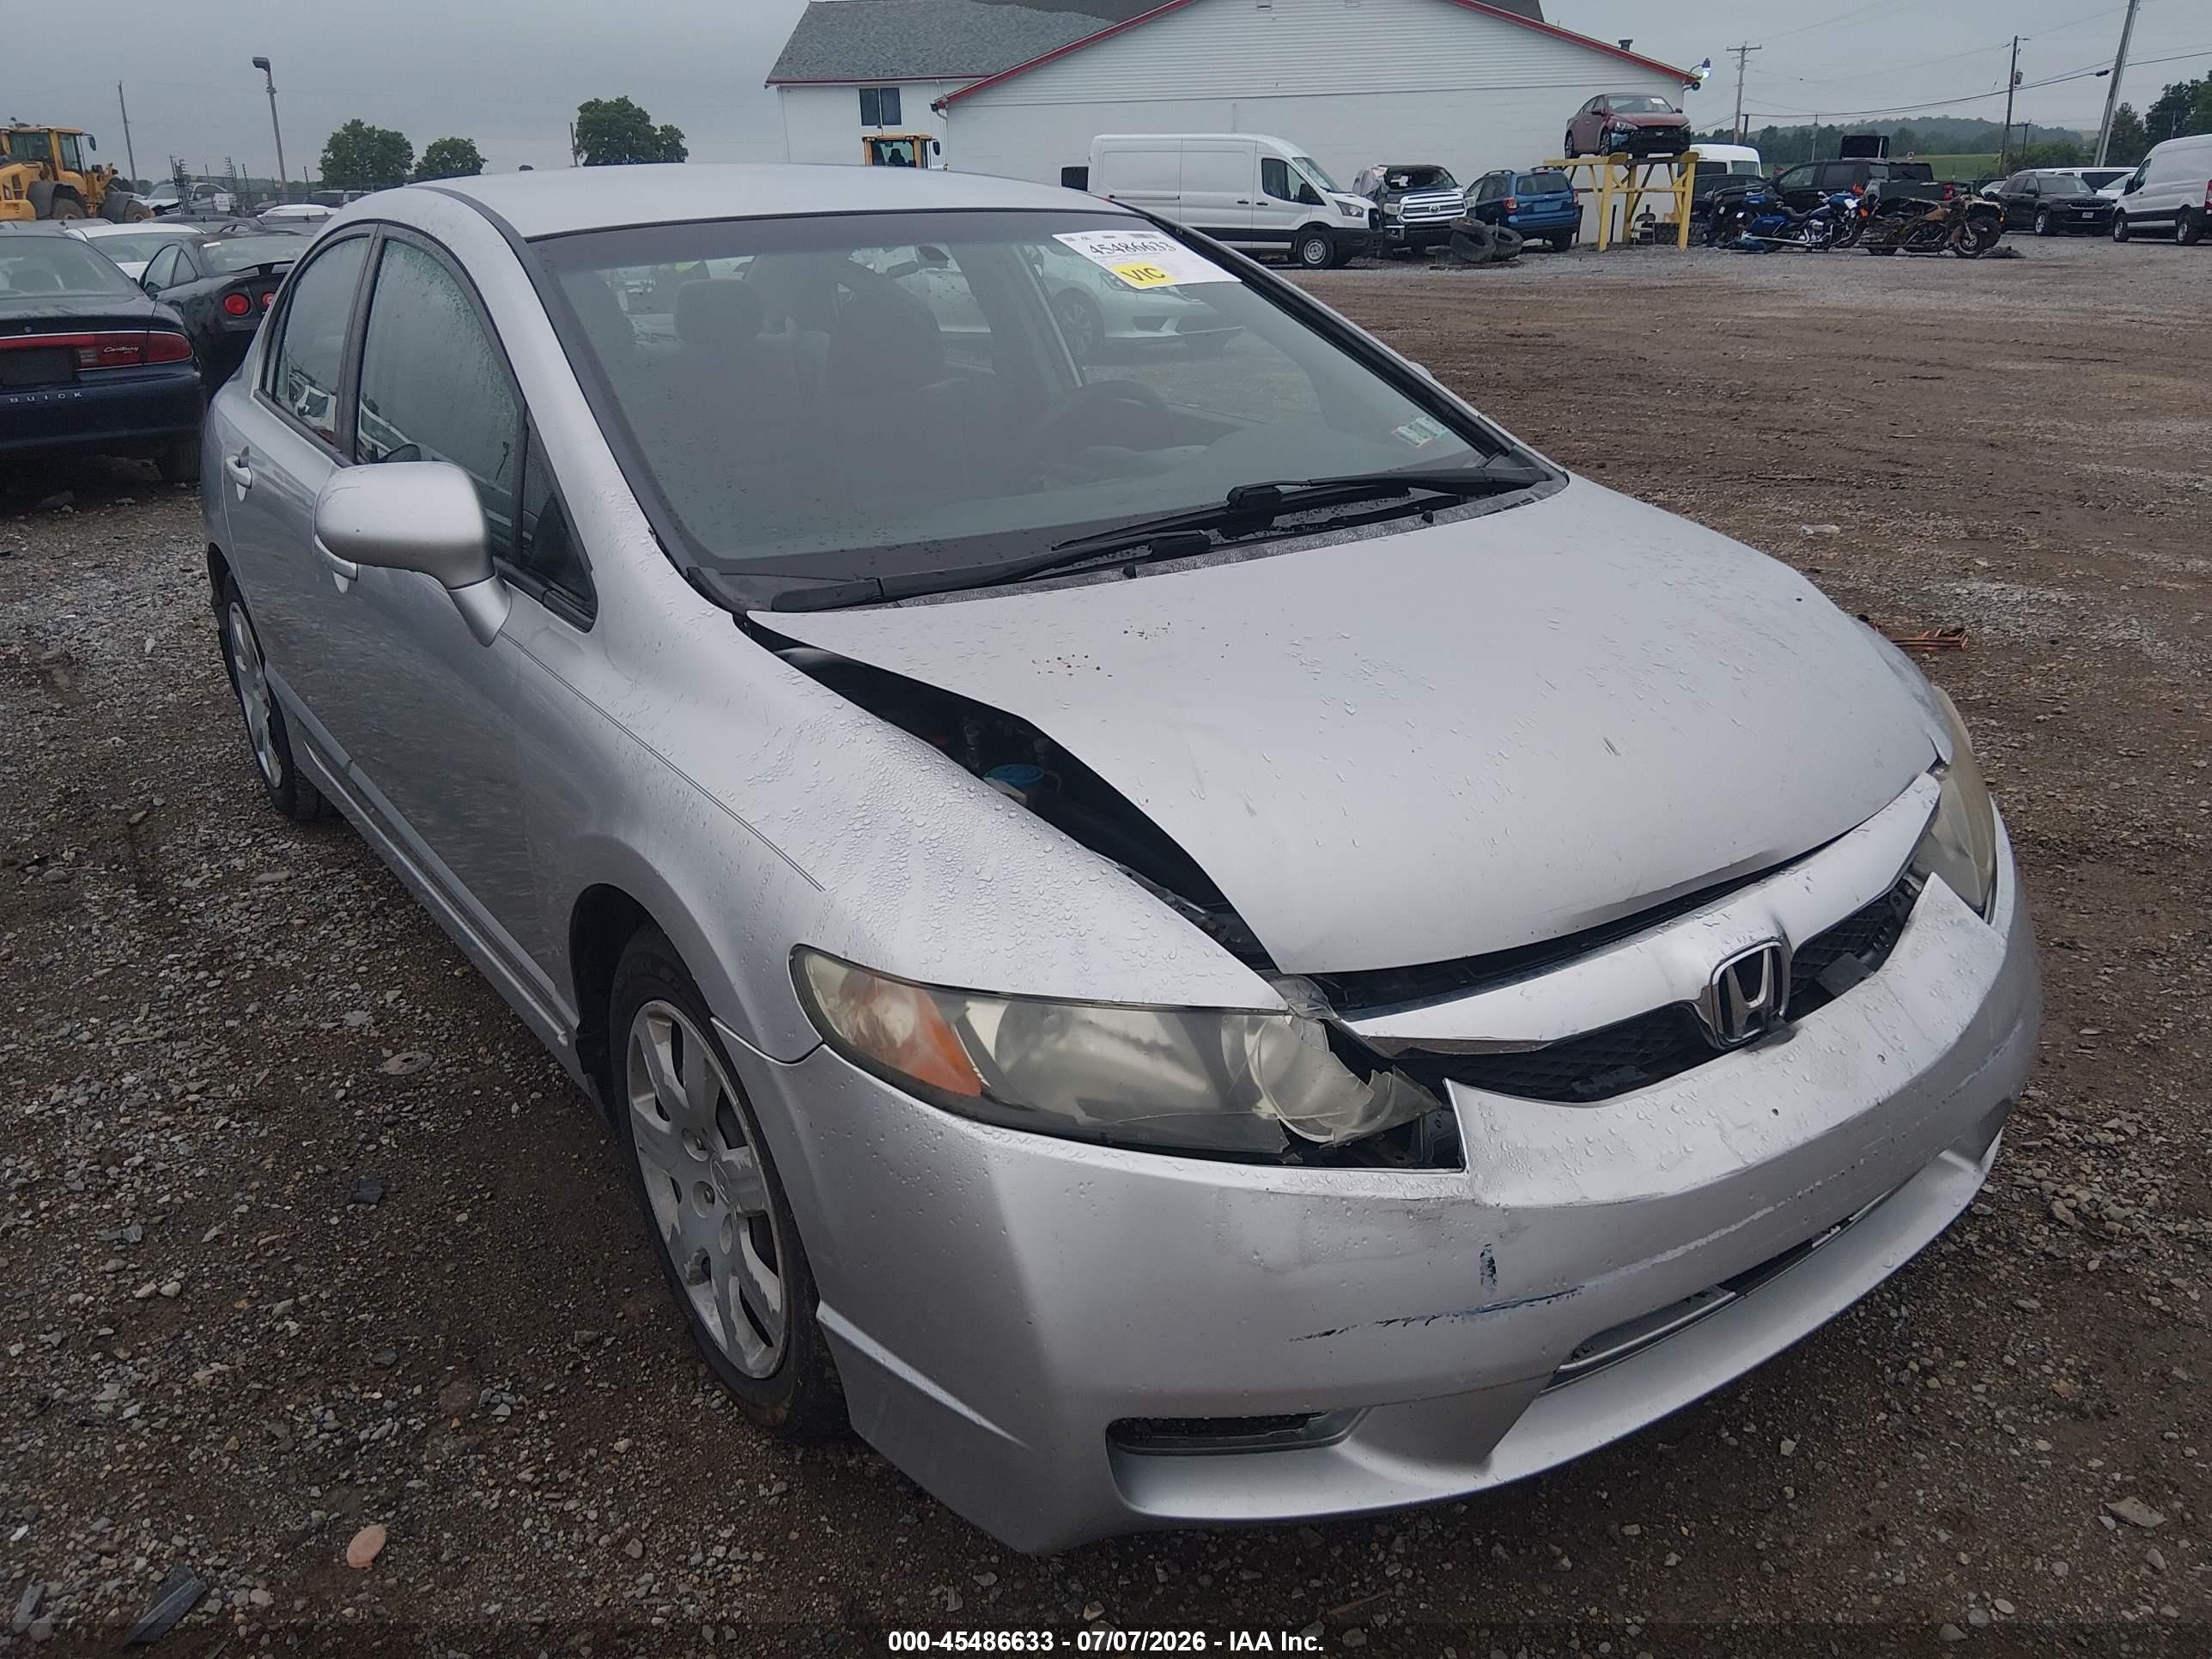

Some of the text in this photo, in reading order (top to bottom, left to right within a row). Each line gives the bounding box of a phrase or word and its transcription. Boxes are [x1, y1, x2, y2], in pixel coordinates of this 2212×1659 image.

[1089, 241, 1176, 255] 45486633
[1121, 267, 1166, 282] VIC
[9, 392, 83, 403] BUICK
